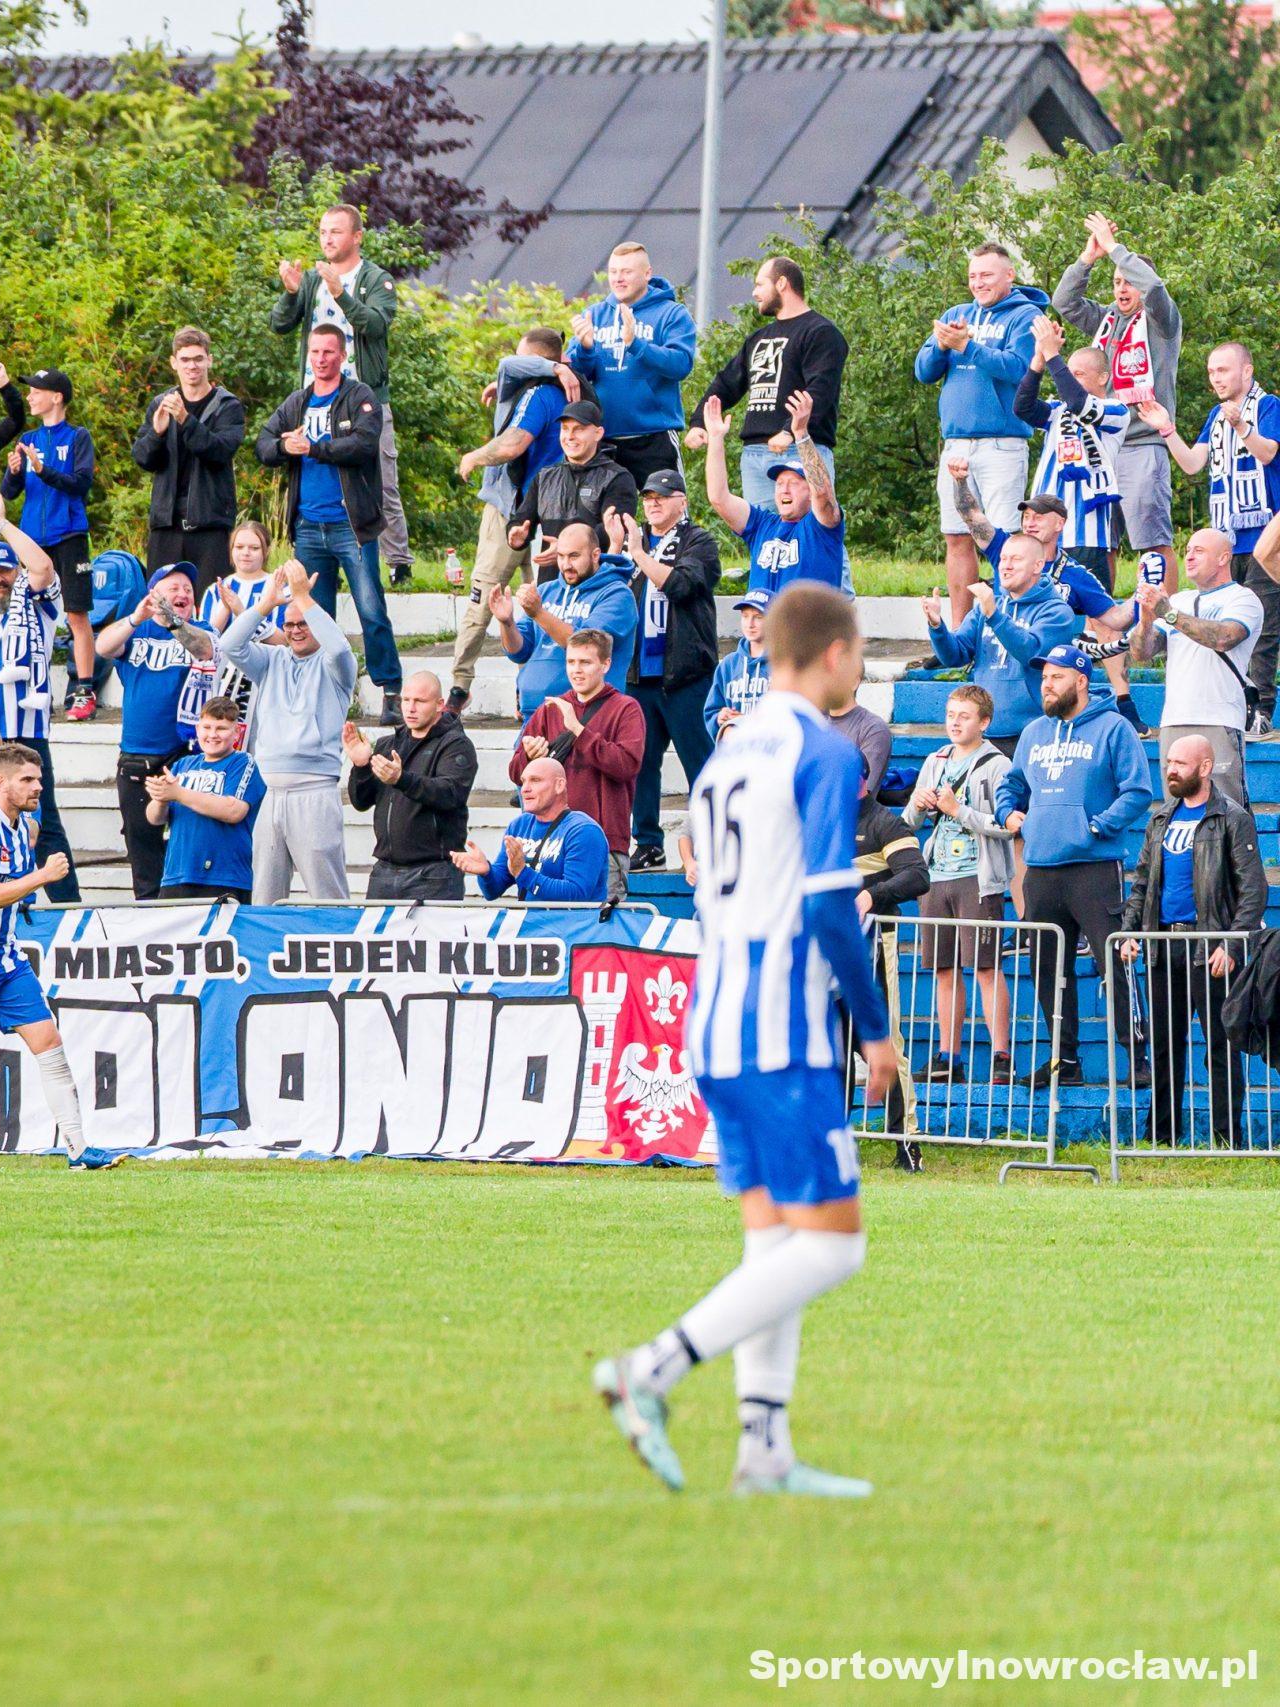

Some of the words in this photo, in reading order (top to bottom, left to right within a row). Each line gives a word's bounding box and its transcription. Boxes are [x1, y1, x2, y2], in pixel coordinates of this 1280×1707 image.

[54, 940, 247, 979] MIASTO,
[272, 940, 427, 973] JEDEN
[439, 942, 560, 976] KLUB
